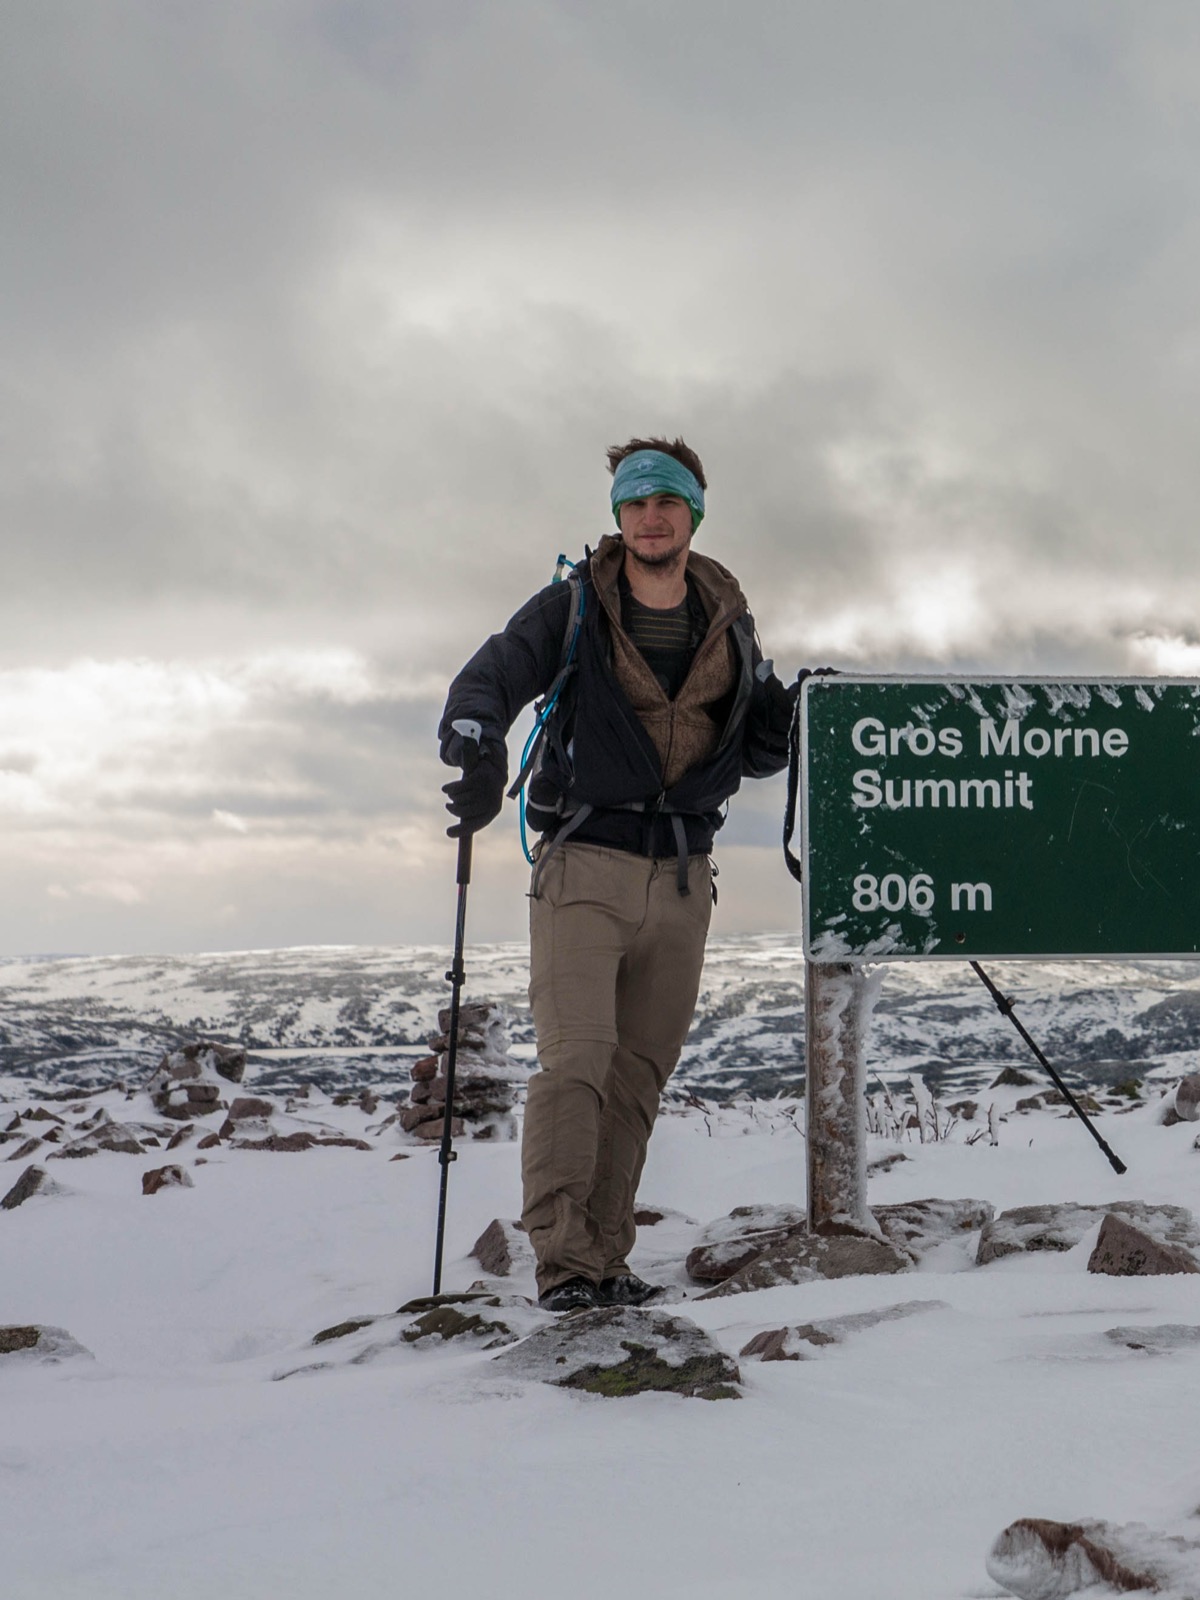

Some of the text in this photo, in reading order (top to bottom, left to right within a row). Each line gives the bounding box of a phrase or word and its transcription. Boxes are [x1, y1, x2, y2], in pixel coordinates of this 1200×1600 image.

[852, 717, 1129, 757] Gros Morne
[852, 769, 1033, 809] Summit
[852, 872, 992, 912] 806 m
